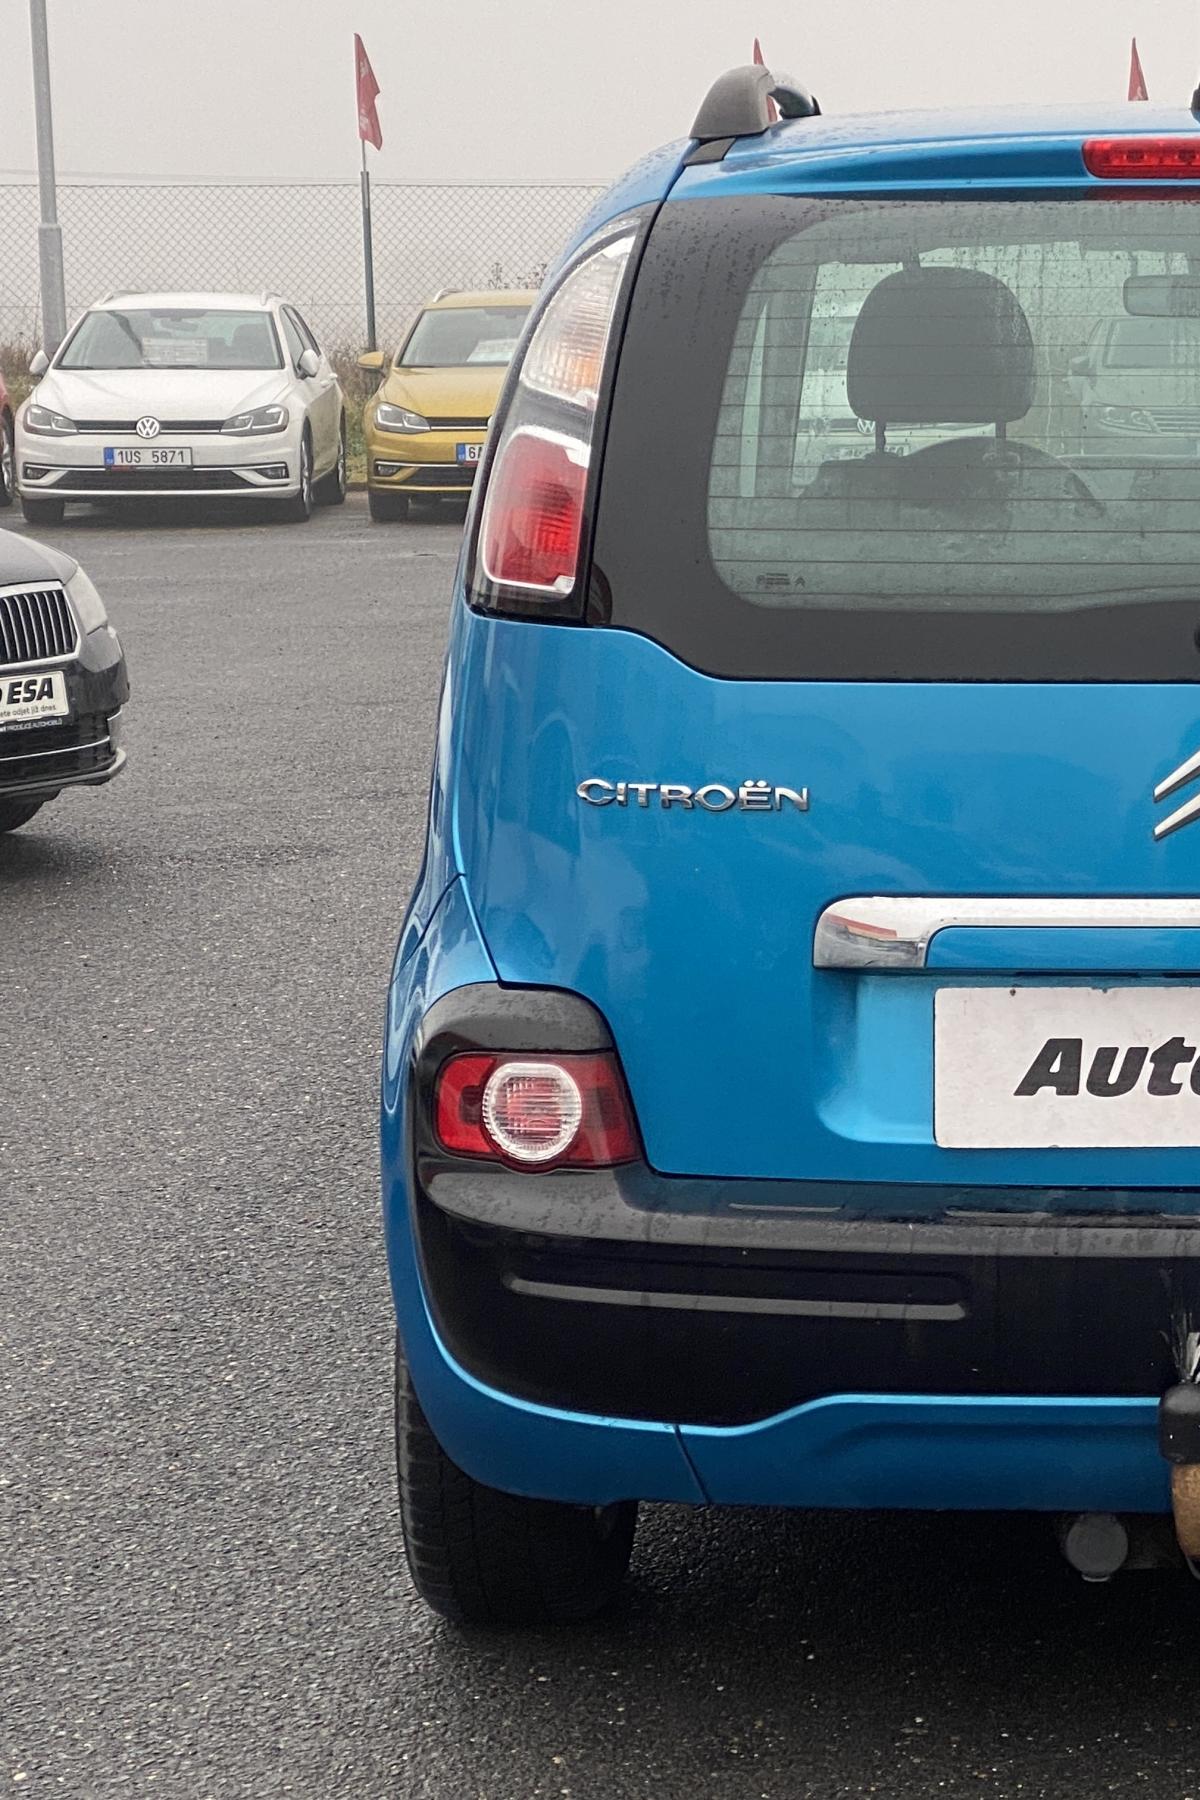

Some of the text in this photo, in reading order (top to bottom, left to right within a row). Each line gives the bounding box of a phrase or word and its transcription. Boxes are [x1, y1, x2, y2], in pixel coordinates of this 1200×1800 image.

[117, 450, 184, 464] 1US 5871
[7, 677, 54, 705] ESA
[576, 778, 809, 812] CITROËN
